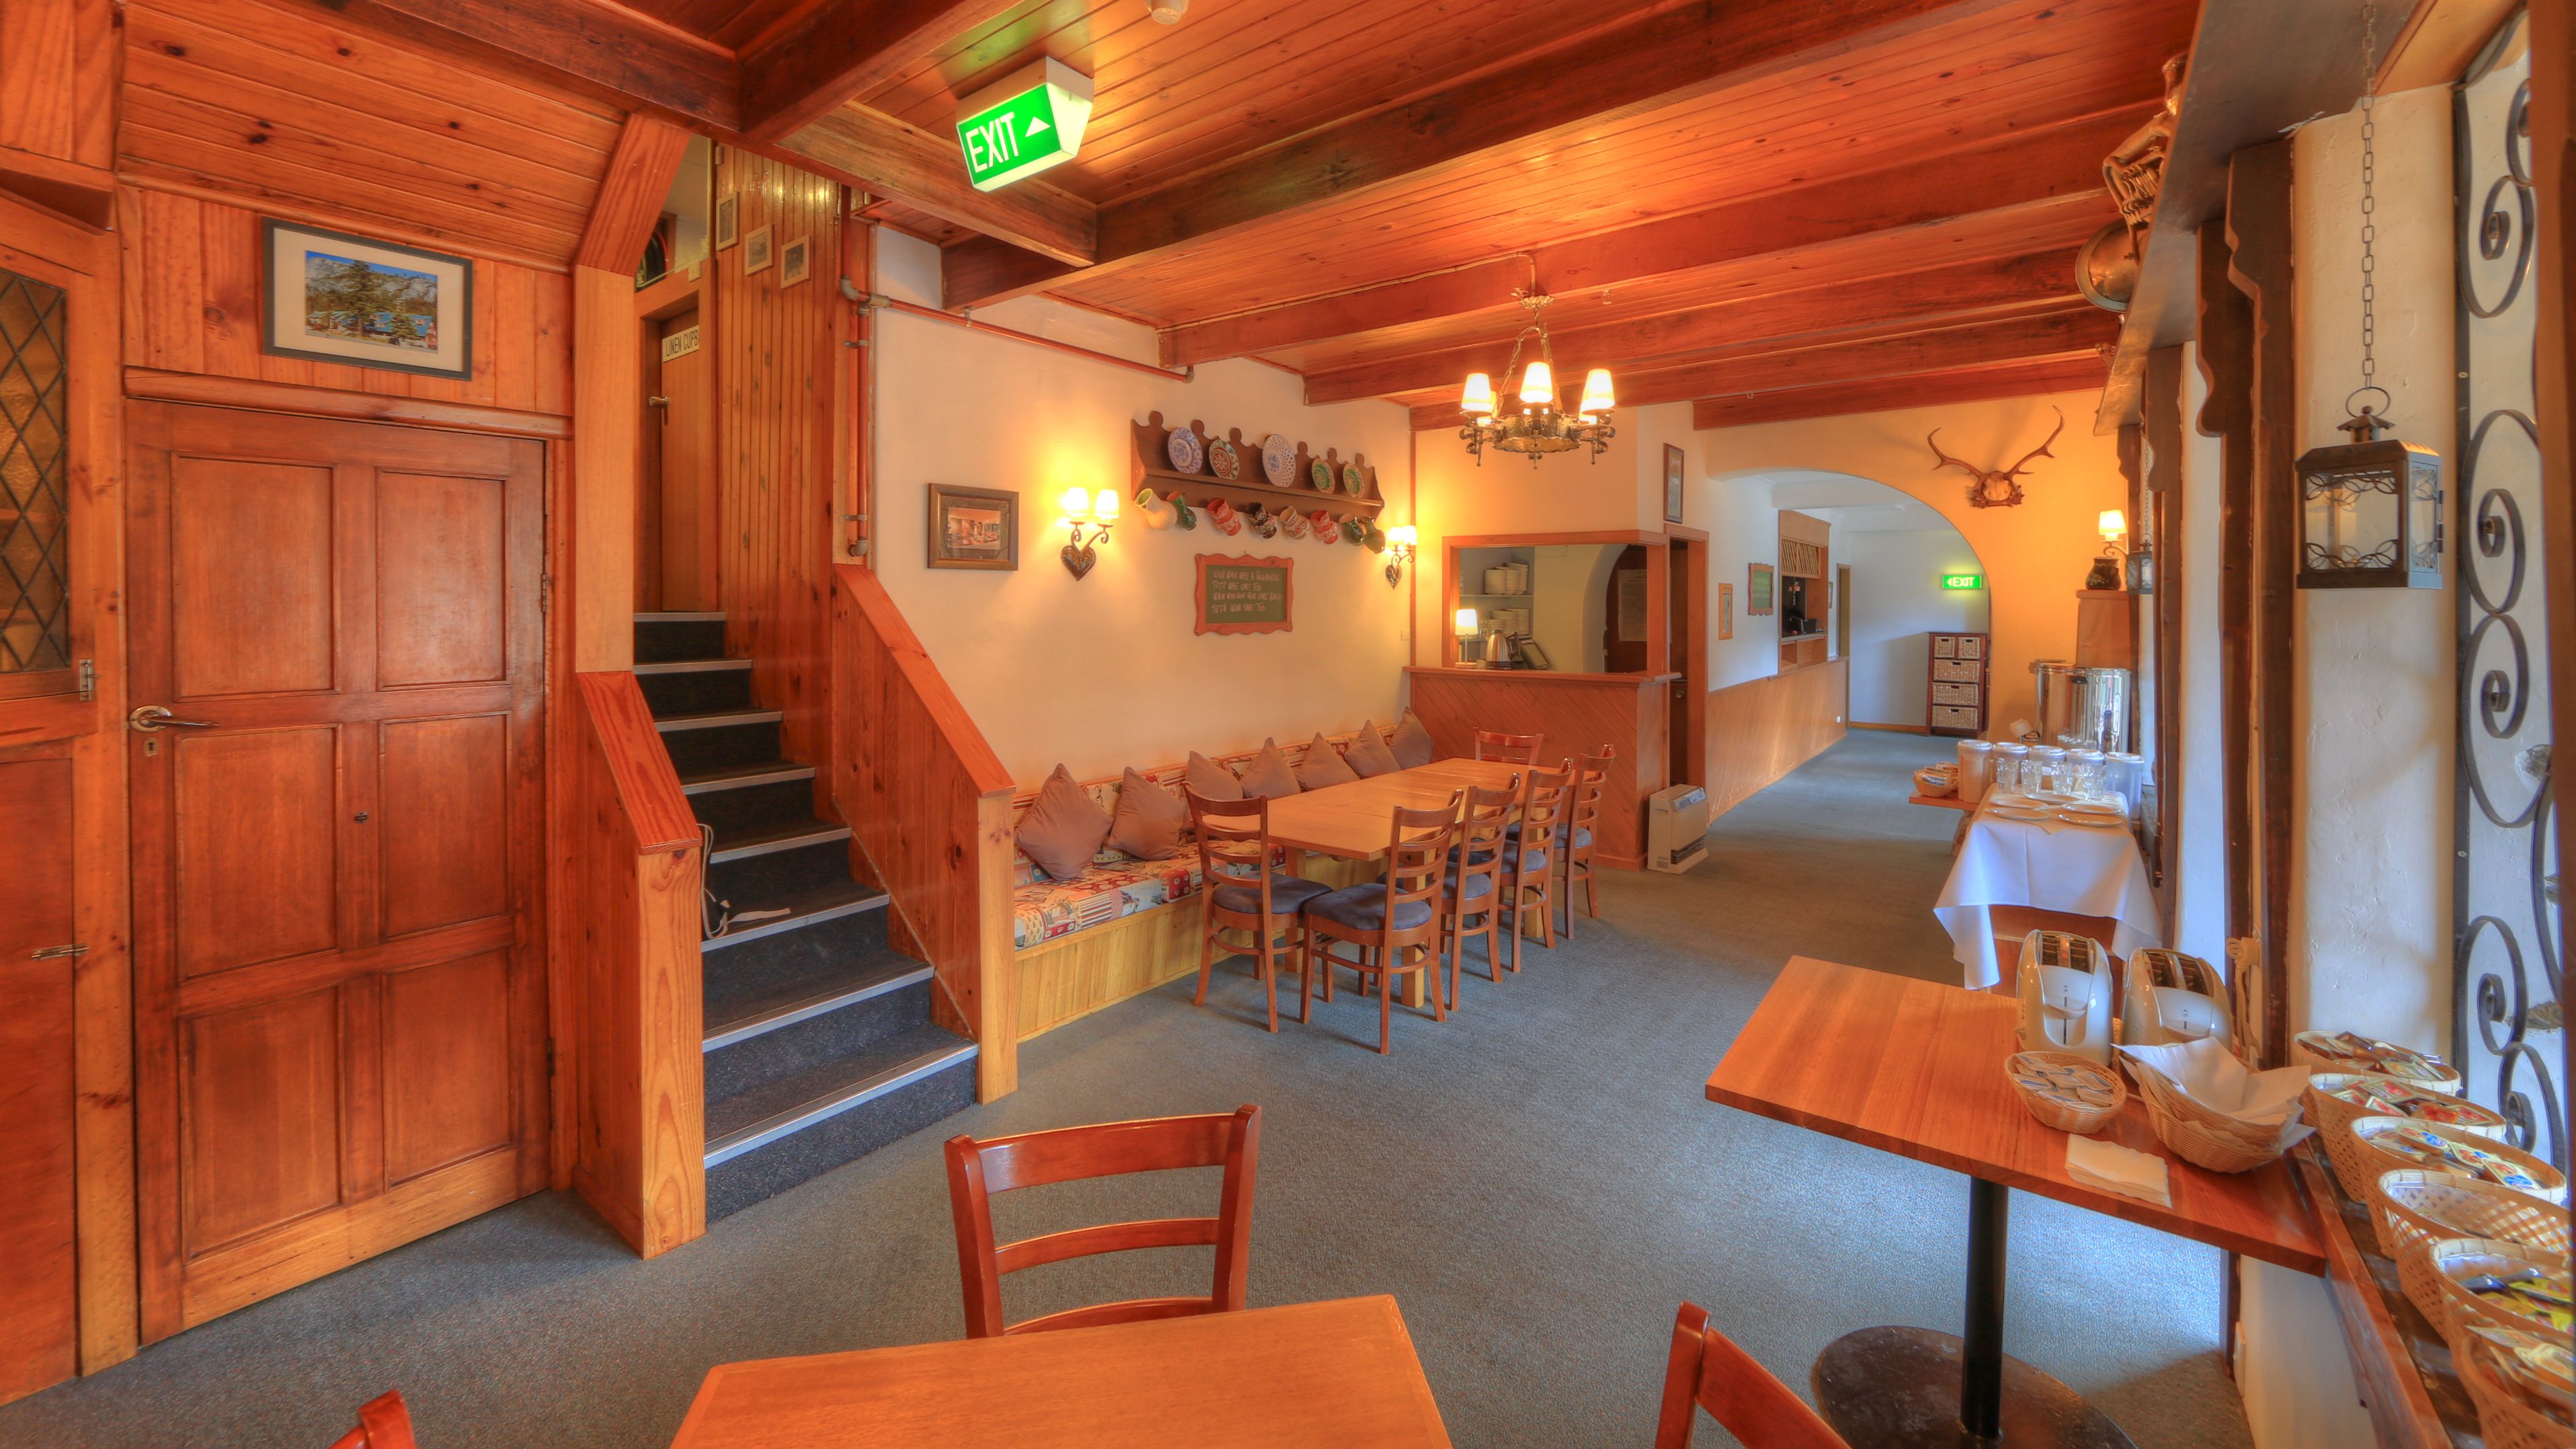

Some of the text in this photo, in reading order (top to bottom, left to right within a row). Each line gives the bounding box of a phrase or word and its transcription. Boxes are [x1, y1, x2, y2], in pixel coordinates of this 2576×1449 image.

[965, 112, 1019, 173] EXIT
[666, 329, 699, 356] LINEN CUPB
[1952, 577, 1975, 587] EXIT
